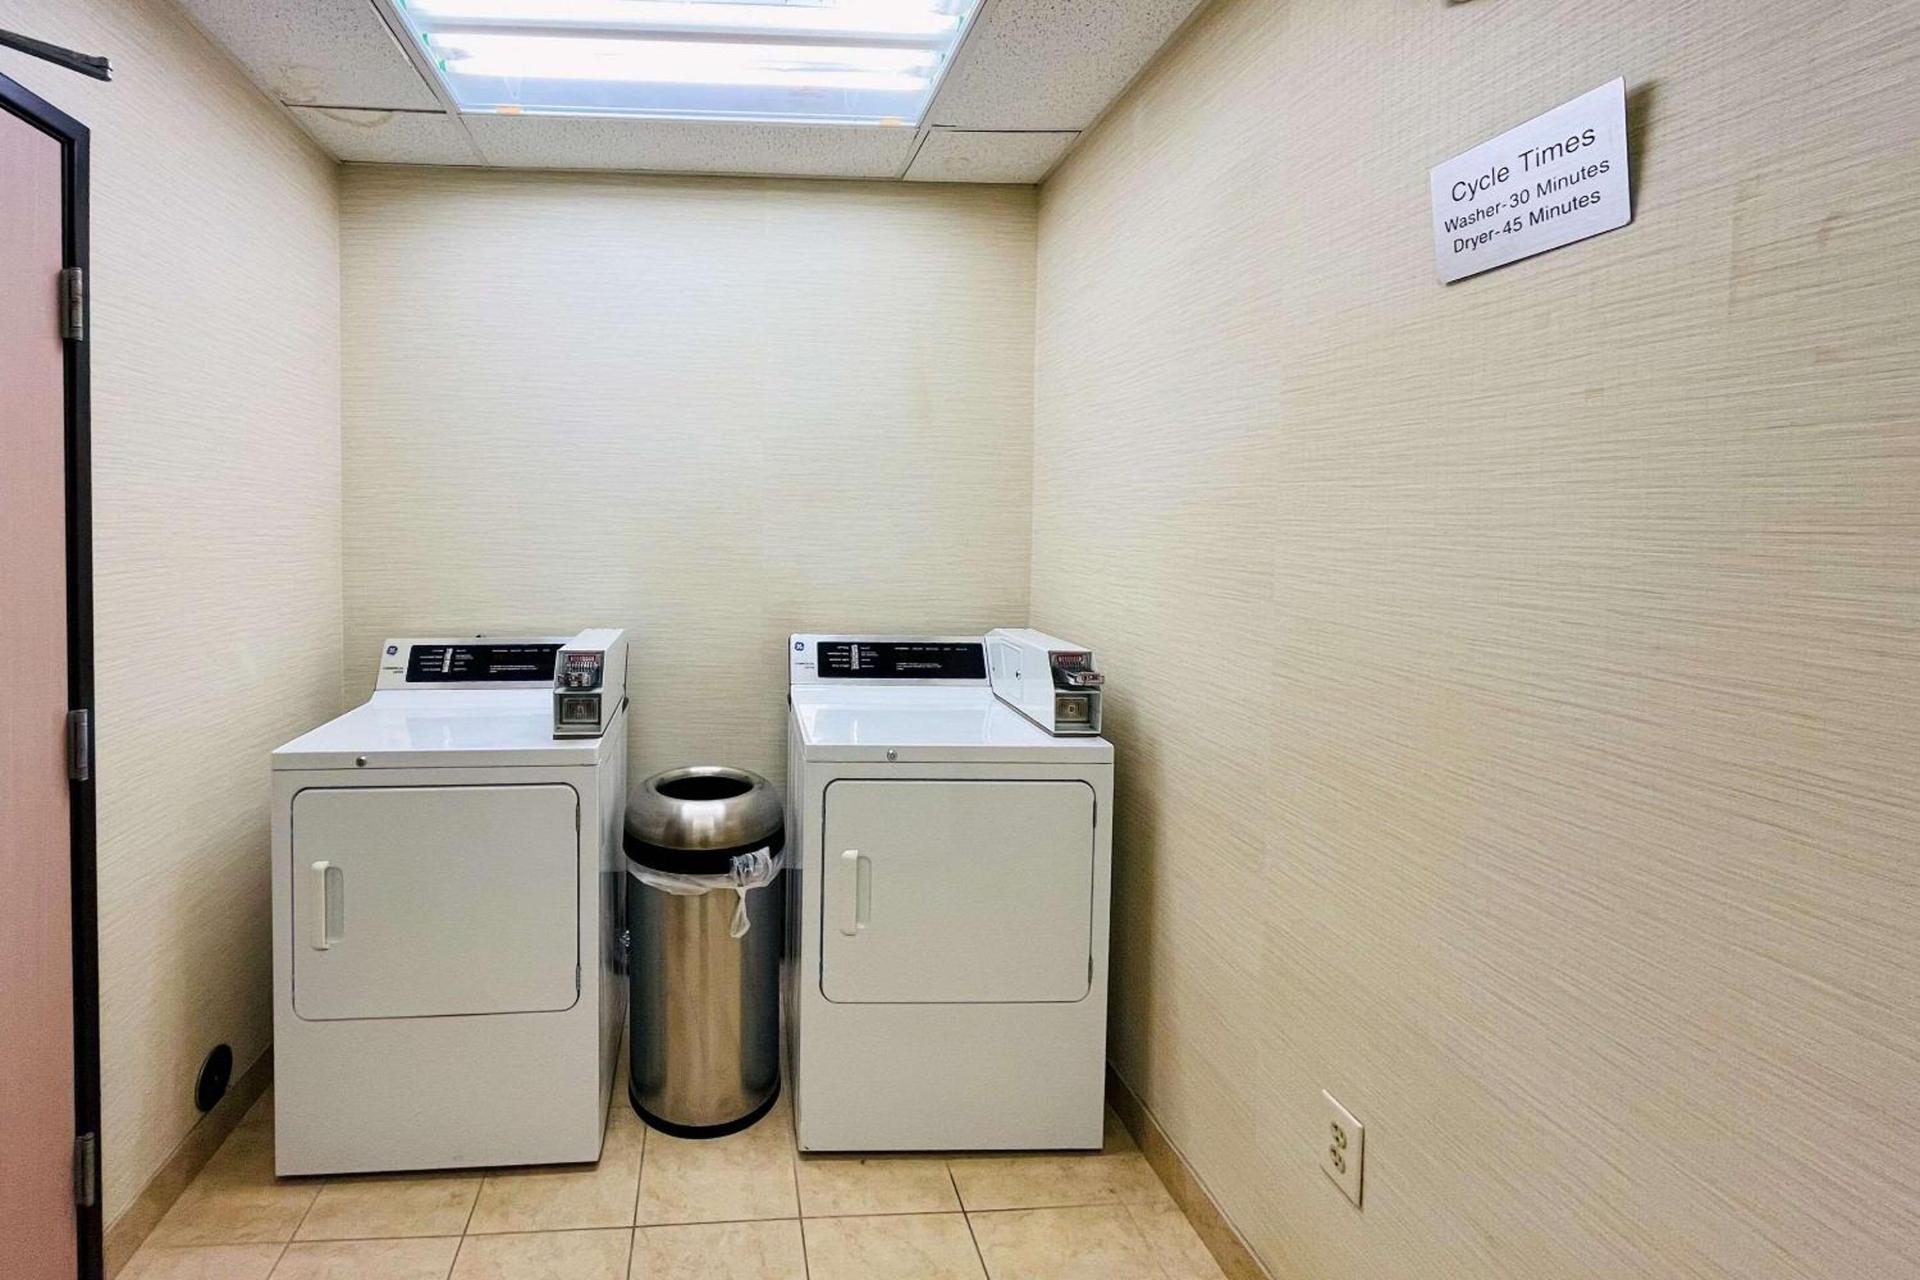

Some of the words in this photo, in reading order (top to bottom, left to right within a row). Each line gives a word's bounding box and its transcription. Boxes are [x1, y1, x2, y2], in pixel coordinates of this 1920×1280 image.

[1452, 166, 1510, 202] Cycle
[1518, 128, 1596, 172] Times
[1536, 159, 1610, 198] Minutes
[1529, 190, 1601, 226] Minutes
